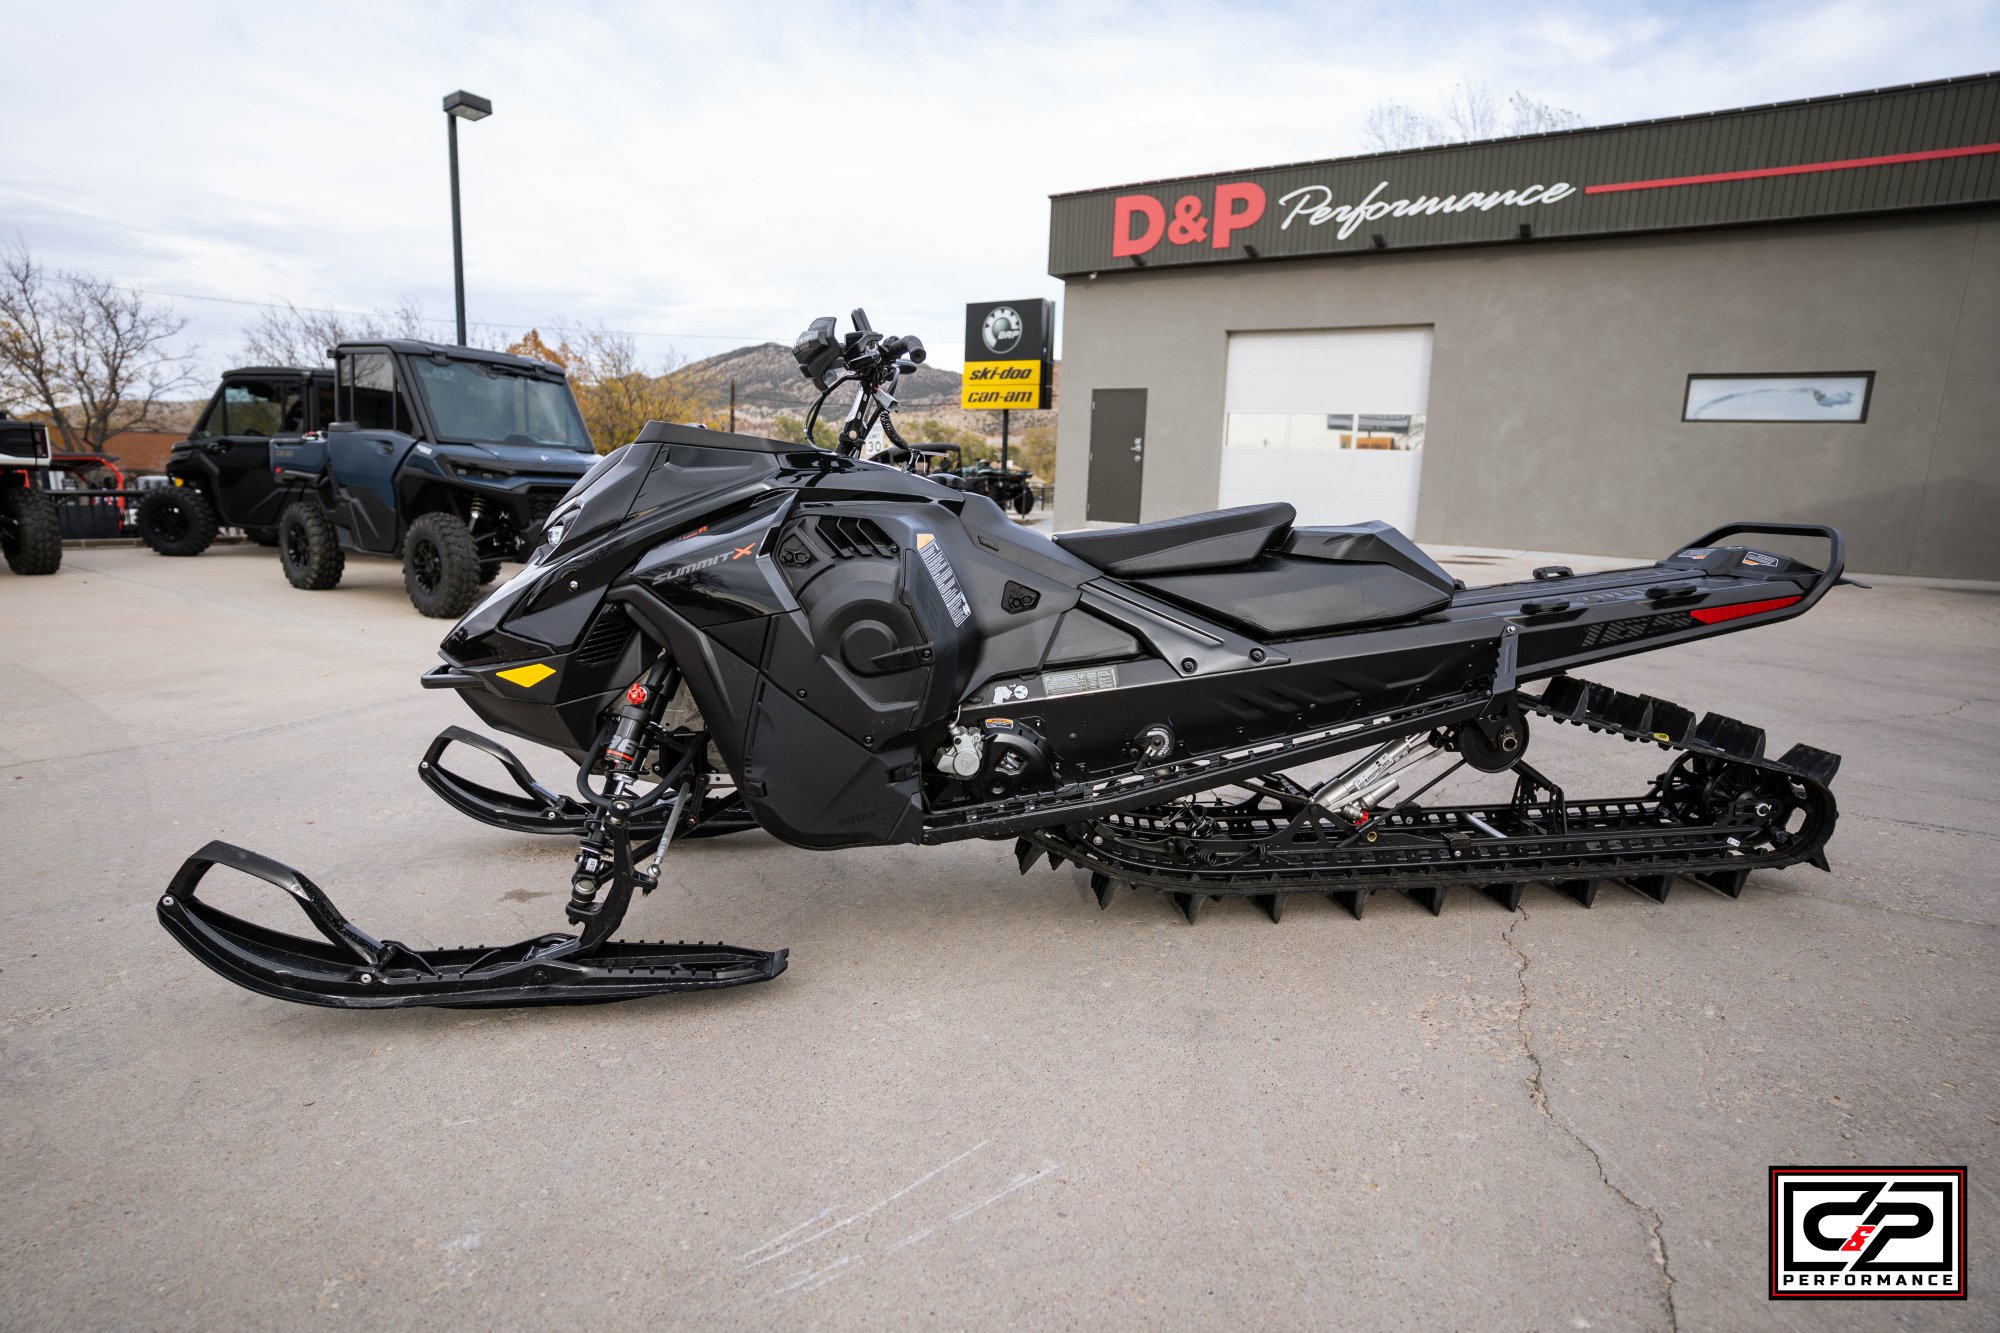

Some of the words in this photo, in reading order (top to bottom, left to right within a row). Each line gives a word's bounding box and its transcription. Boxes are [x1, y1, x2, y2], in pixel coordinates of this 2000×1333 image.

[1111, 181, 1267, 258] D&P
[1278, 180, 1577, 240] Performance
[997, 330, 1020, 340] BRP
[968, 366, 1033, 381] ski-doo
[967, 390, 1033, 403] can-am
[868, 441, 882, 452] 30
[652, 550, 735, 586] SUMMIT
[837, 810, 879, 827] ROTAX
